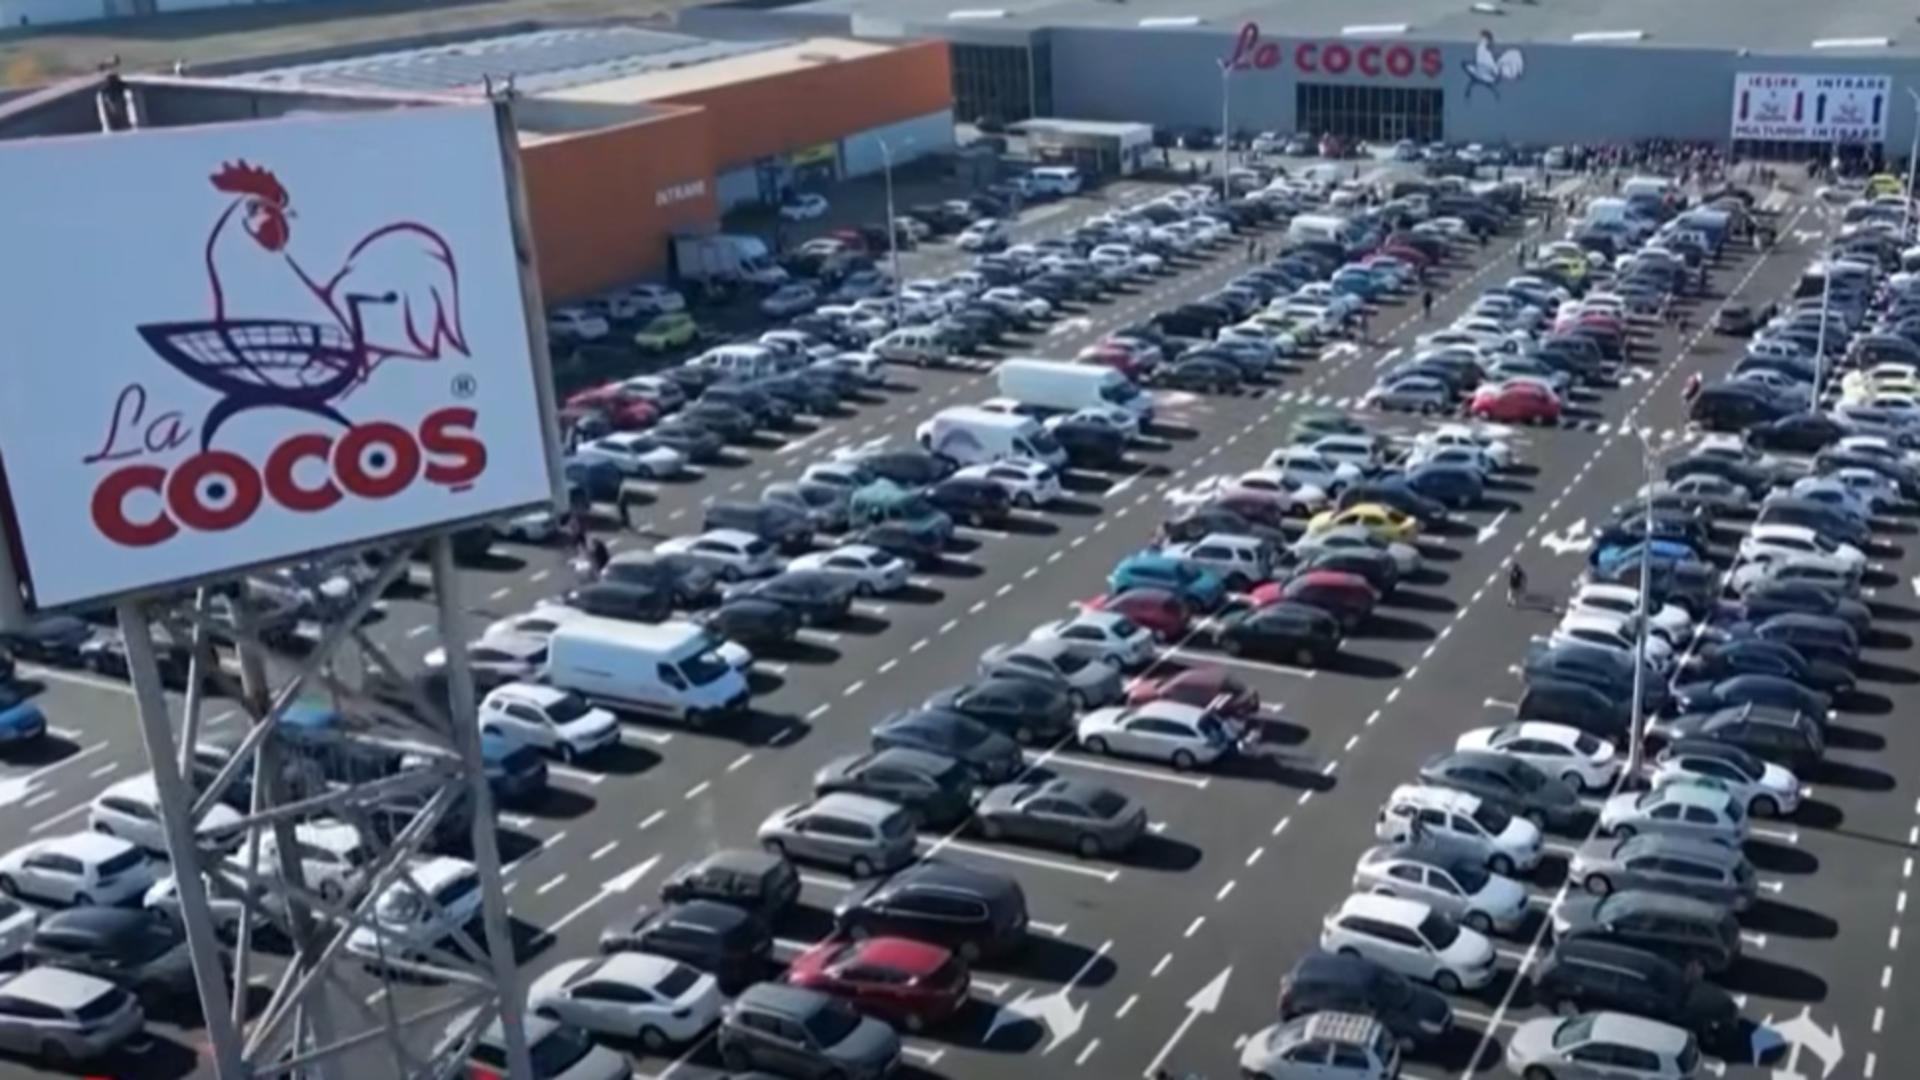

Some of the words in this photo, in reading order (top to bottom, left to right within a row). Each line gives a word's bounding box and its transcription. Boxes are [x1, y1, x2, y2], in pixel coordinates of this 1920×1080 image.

[1224, 22, 1283, 71] La
[1816, 78, 1885, 89] INTRARE
[83, 382, 194, 464] La
